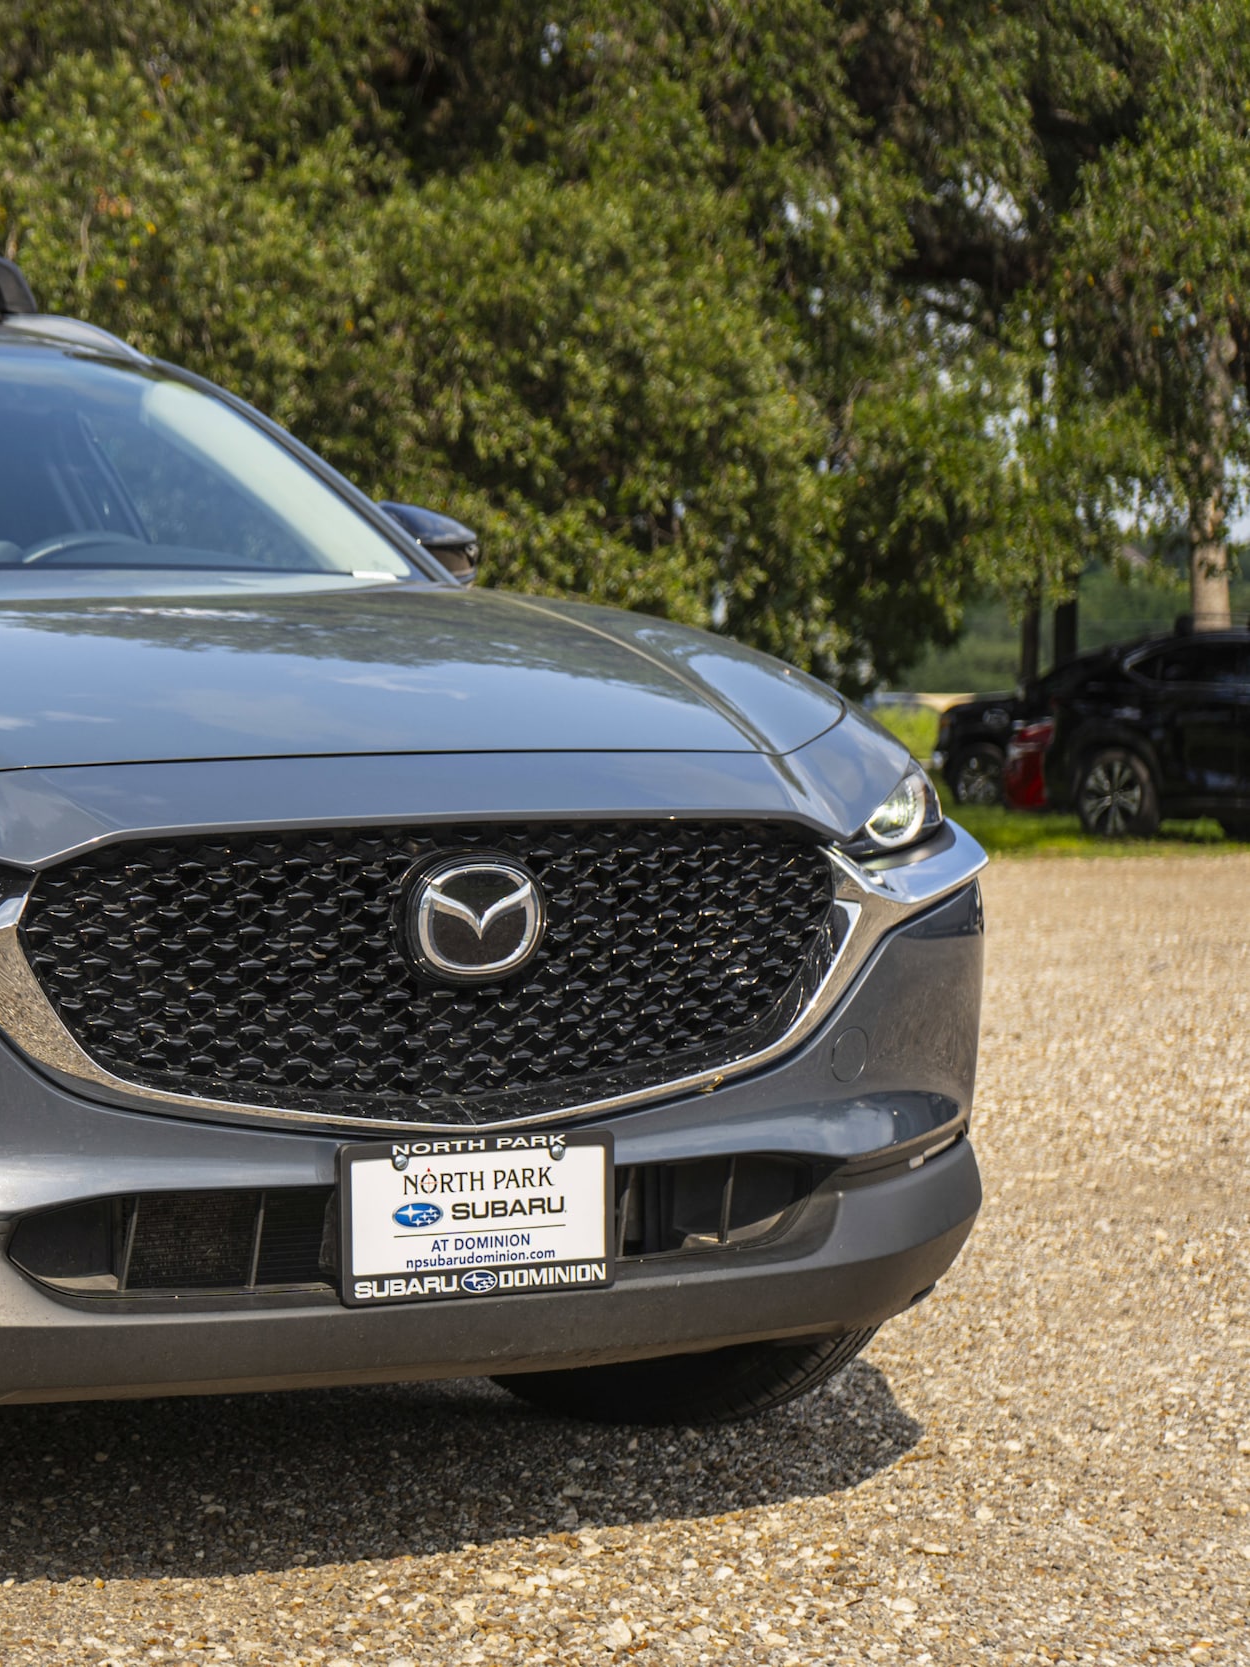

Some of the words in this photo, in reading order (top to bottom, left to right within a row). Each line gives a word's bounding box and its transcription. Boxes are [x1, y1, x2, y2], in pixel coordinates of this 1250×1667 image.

[392, 1139, 486, 1156] NORTH
[496, 1134, 567, 1149] PARK
[403, 1170, 485, 1196] NORTH
[493, 1166, 555, 1190] PARK
[451, 1196, 565, 1220] SUBARU
[431, 1239, 450, 1253] AT
[454, 1233, 531, 1252] DOMINION
[406, 1248, 556, 1272] npsubarudominion.com
[354, 1275, 460, 1299] SUBARU
[499, 1263, 607, 1288] DOMINION
